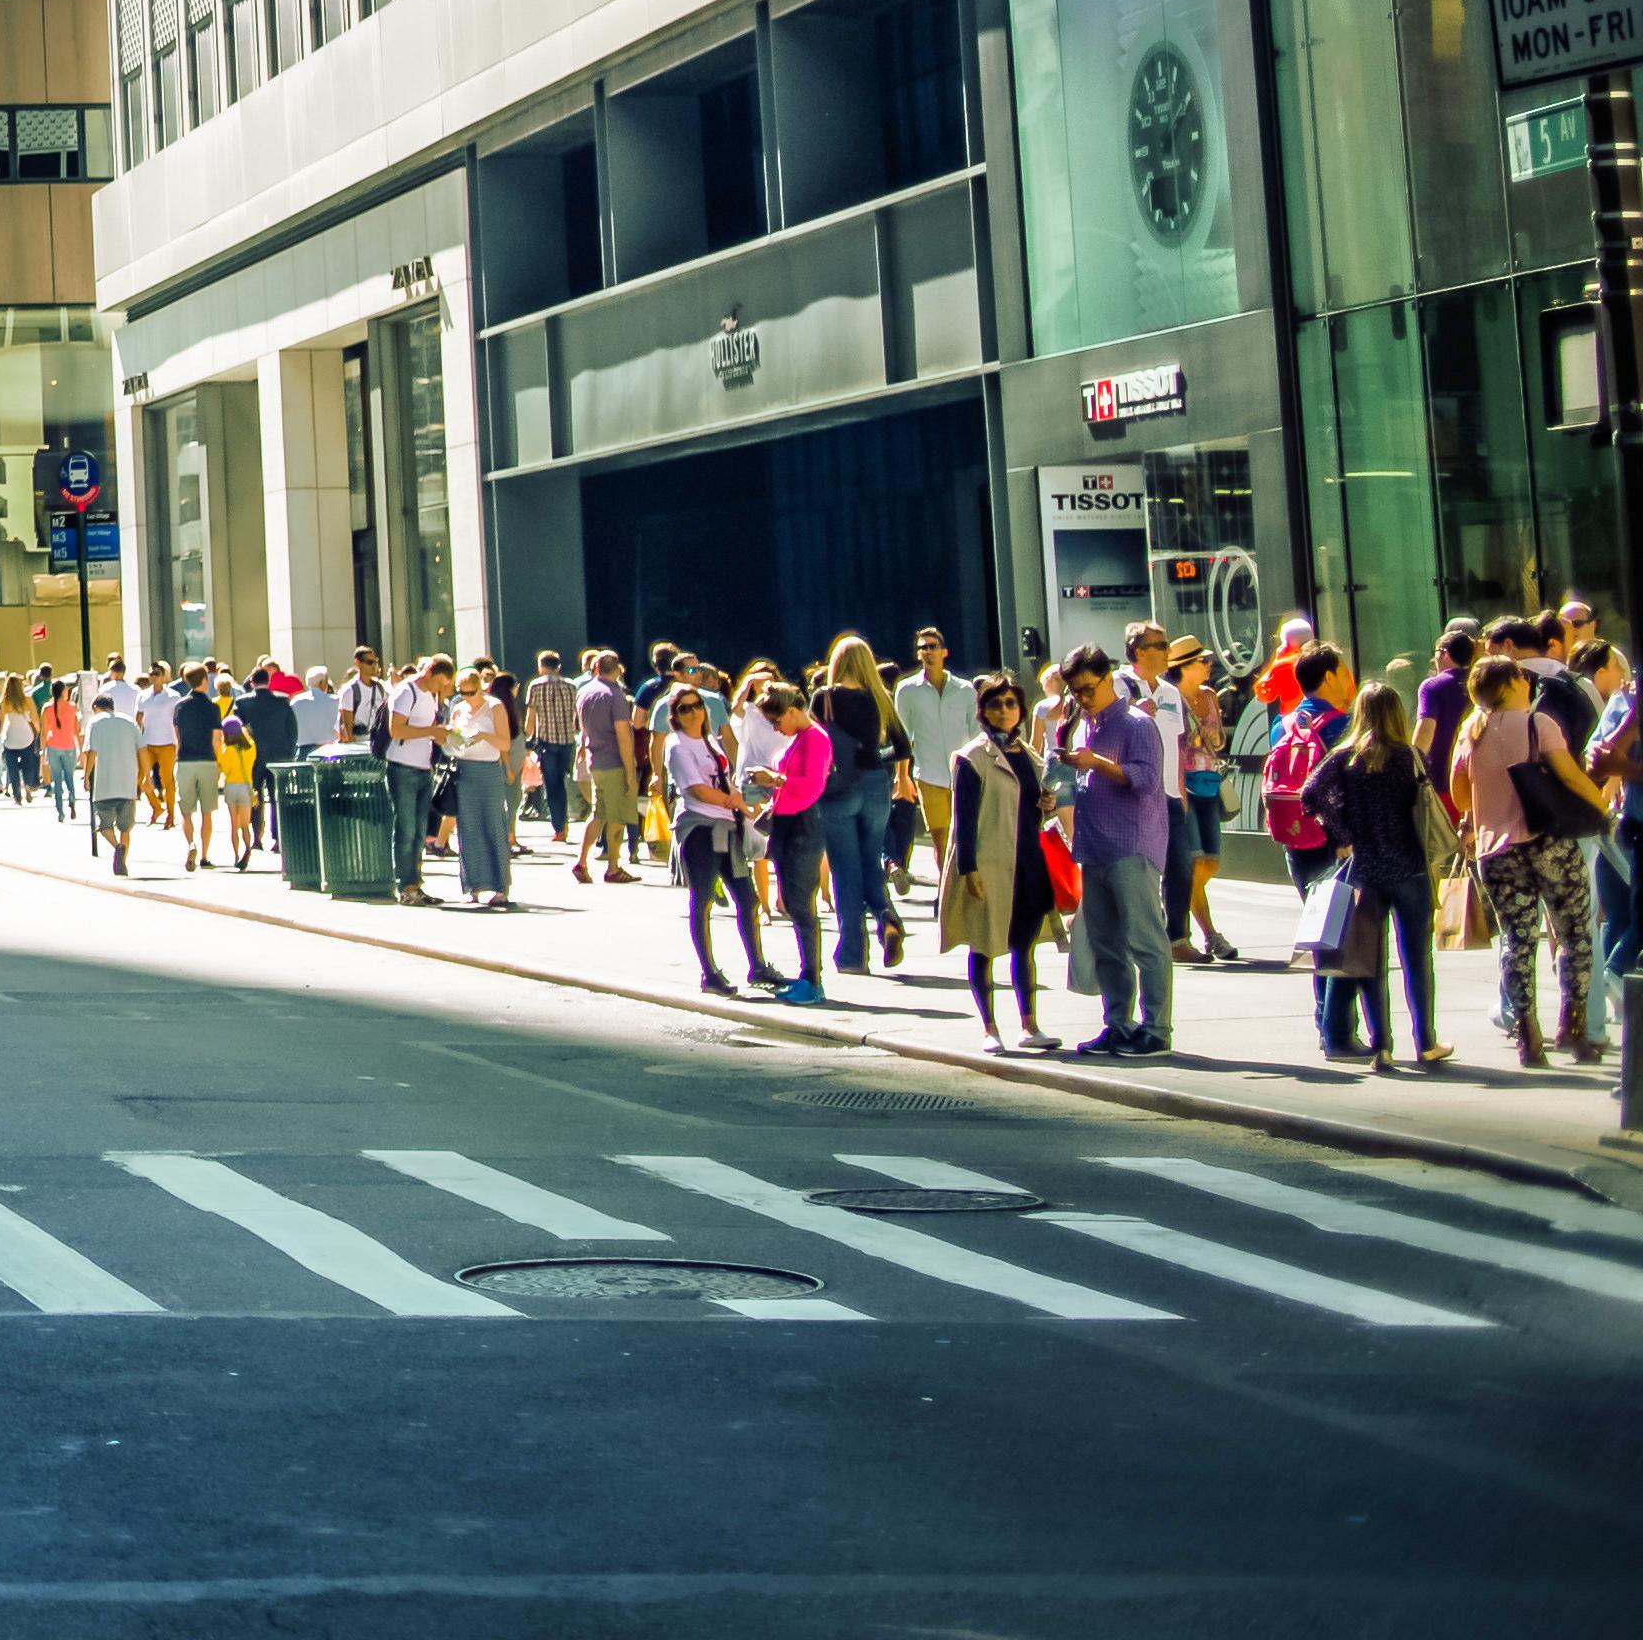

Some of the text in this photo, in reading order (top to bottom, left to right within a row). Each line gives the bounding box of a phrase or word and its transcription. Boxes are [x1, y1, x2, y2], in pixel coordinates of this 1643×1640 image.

[1539, 119, 1552, 164] 5
[710, 330, 756, 369] HOLLISTER
[1115, 363, 1180, 404] TISSOT
[1051, 492, 1144, 511] TISSOT
[52, 516, 66, 528] M2
[52, 531, 66, 543] M3
